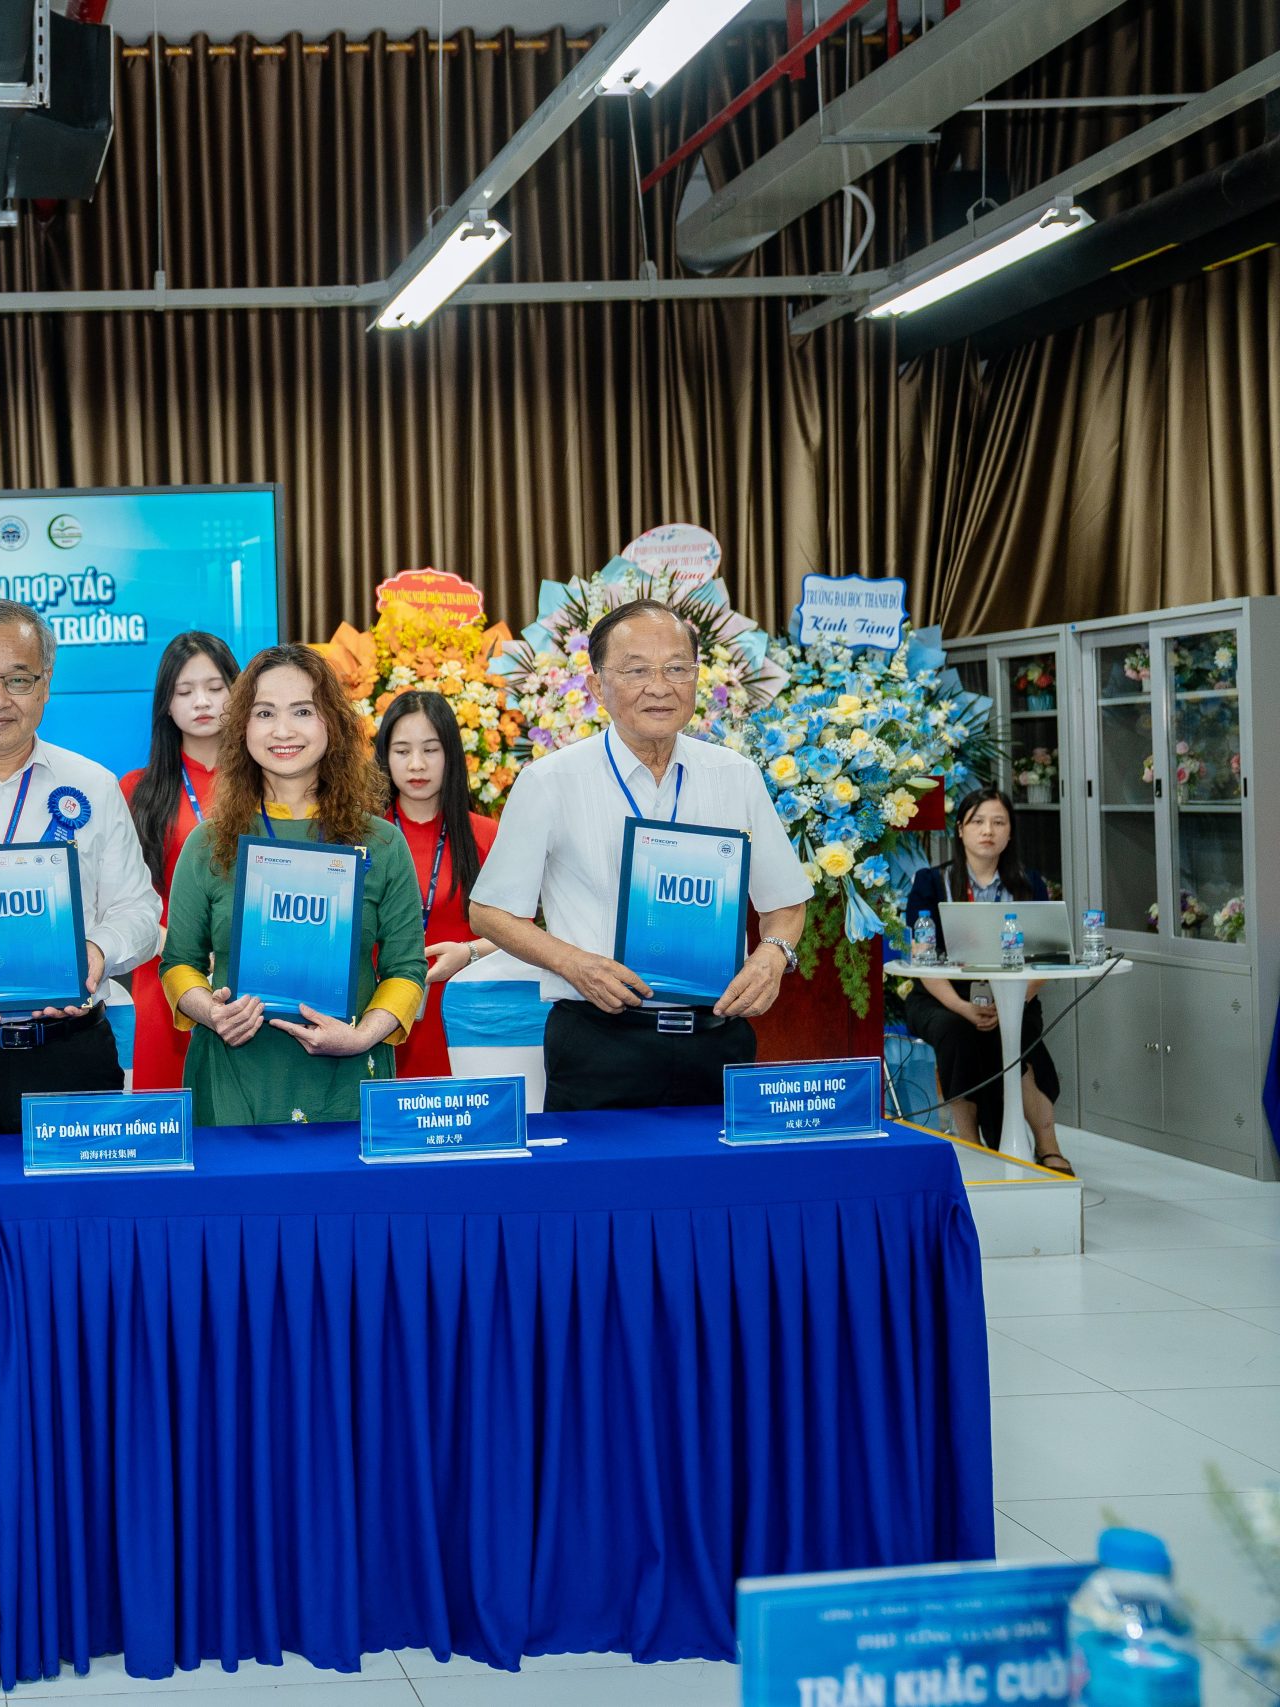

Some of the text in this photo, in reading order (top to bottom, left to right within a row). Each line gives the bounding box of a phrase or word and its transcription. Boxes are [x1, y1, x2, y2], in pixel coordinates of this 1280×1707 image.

[14, 574, 64, 610] HỢP
[71, 567, 114, 603] TÁC
[806, 585, 834, 605] TRƯỜNG
[834, 591, 847, 609] ĐẠI
[848, 591, 863, 609] HỌC
[50, 609, 145, 643] TRƯỜNG
[810, 615, 895, 638] Kính Tặng
[657, 873, 711, 905] MOU
[272, 892, 325, 923] MOU
[759, 1078, 846, 1095] TRƯỜNG ĐẠI HỌC
[397, 1093, 489, 1110] TRƯỜNG ĐẠI HỌC
[770, 1096, 836, 1113] THÀNH ĐÔNG
[36, 1118, 179, 1141] TẬP ĐOÀN KHKT HỒNG HẢI
[416, 1110, 471, 1128] THÀNH ĐÔ
[785, 1118, 820, 1129] 成東大學
[426, 1133, 463, 1145] 成都大學
[80, 1148, 137, 1160] 鴻海科技集團
[796, 1661, 886, 1707] TRẦN
[895, 1653, 988, 1707] KHẮC
